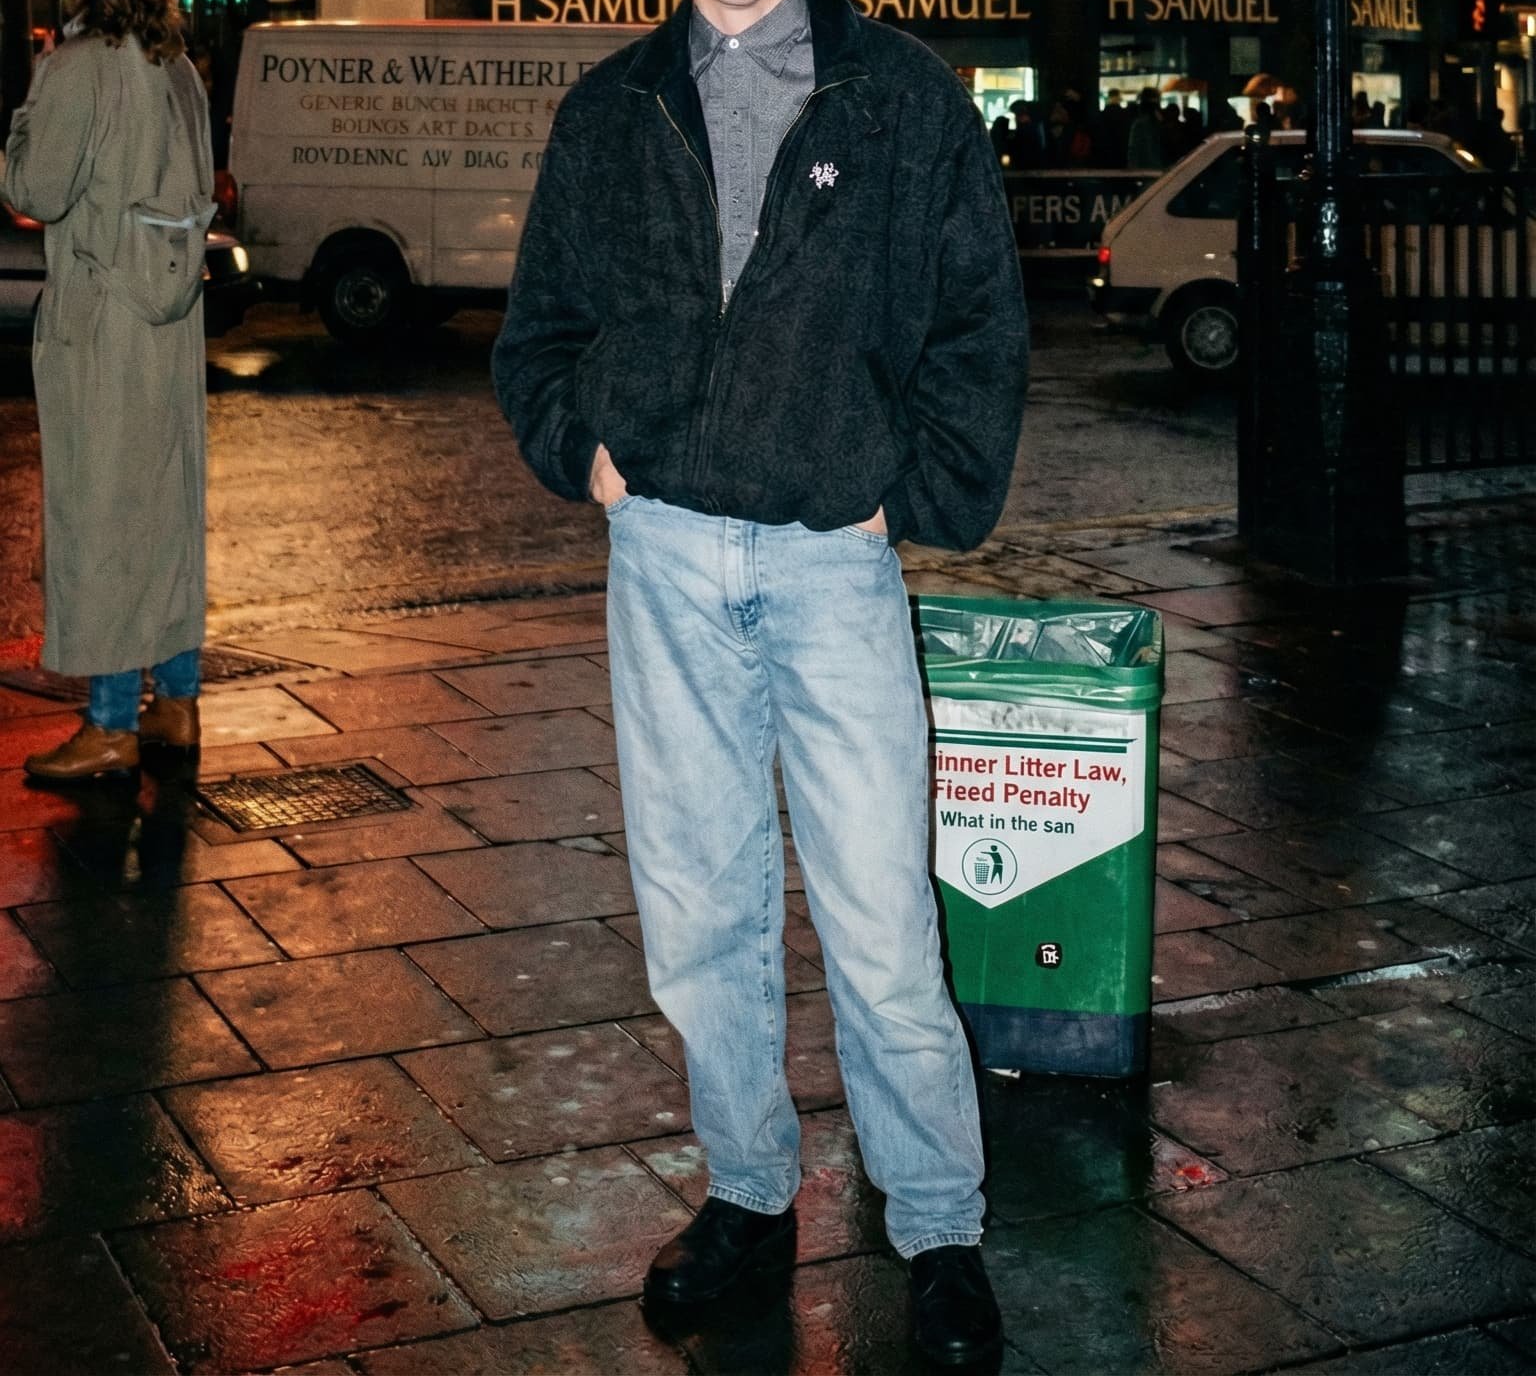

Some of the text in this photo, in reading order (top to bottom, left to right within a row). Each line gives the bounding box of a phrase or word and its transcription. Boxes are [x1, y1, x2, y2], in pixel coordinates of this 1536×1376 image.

[260, 55, 376, 83] POYNER
[382, 58, 403, 85] &
[300, 95, 384, 111] GENERIC
[1005, 755, 1067, 779] Litter
[1073, 759, 1127, 785] Law,
[1003, 783, 1090, 814] Penalty
[940, 810, 1075, 834] What in the san
